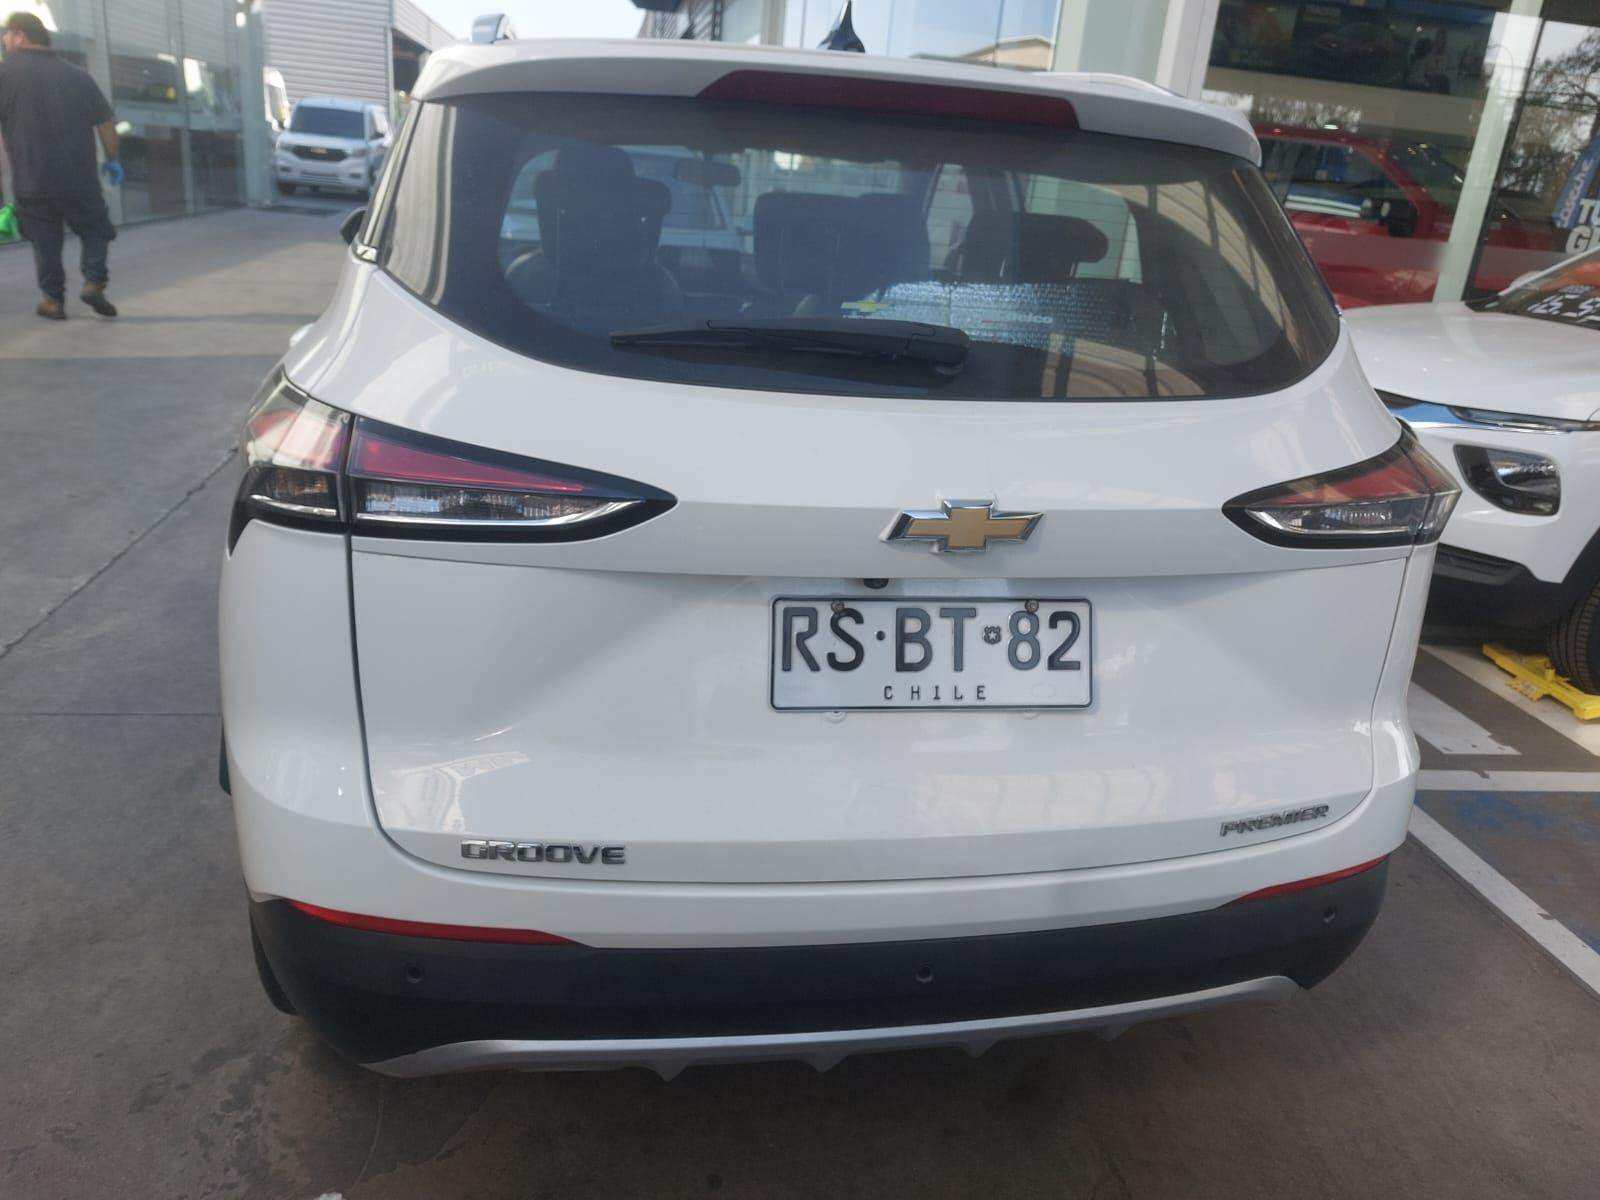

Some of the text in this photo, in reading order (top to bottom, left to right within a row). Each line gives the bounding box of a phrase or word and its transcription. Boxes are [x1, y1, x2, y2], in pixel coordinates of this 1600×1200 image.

[883, 685, 986, 700] CHILE
[1220, 804, 1330, 837] PREMIER
[461, 840, 626, 865] GROOVE
